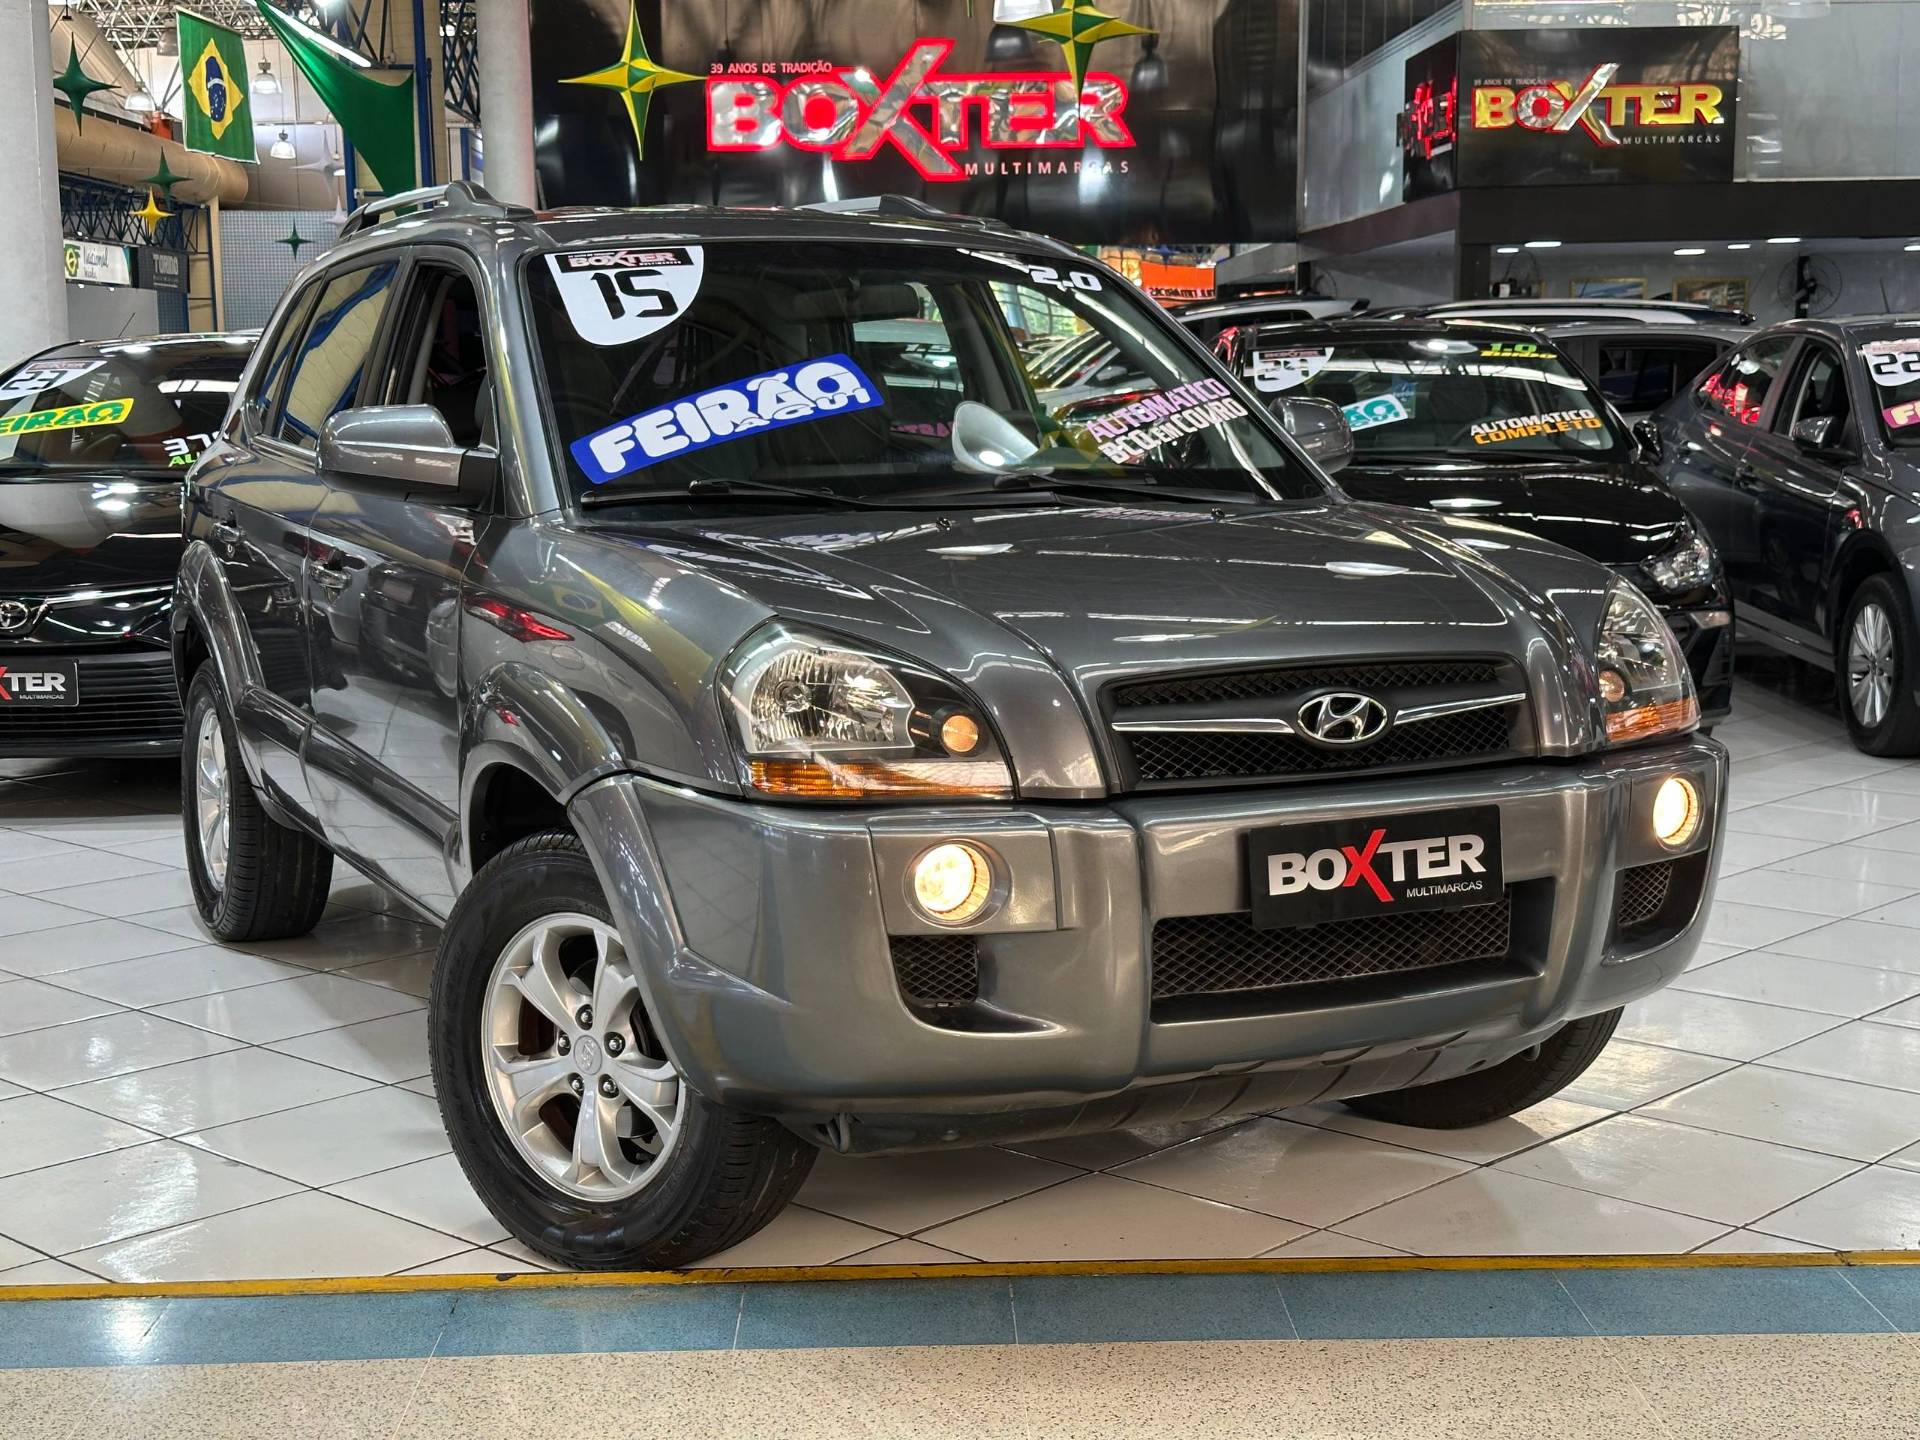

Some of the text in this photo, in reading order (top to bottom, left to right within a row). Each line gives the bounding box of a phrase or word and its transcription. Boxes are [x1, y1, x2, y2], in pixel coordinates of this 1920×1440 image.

[710, 59, 832, 74] 39 ANOS DE TRADIÇÃO
[706, 38, 1135, 181] BOXTER
[1472, 62, 1725, 147] BOXTER
[1622, 134, 1722, 146] MULTIMARCAS
[965, 160, 1129, 176] MULTIMARCAS
[568, 250, 677, 268] BOXTER
[1028, 264, 1102, 291] 2.0
[591, 269, 678, 320] 15
[1490, 343, 1537, 353] 1.0
[589, 362, 871, 473] FEIRÃO
[1891, 402, 1920, 425] F
[1474, 418, 1602, 445] COMPLETO
[1268, 829, 1487, 903] BOXTER
[1406, 881, 1483, 898] MULTIMARCAS
